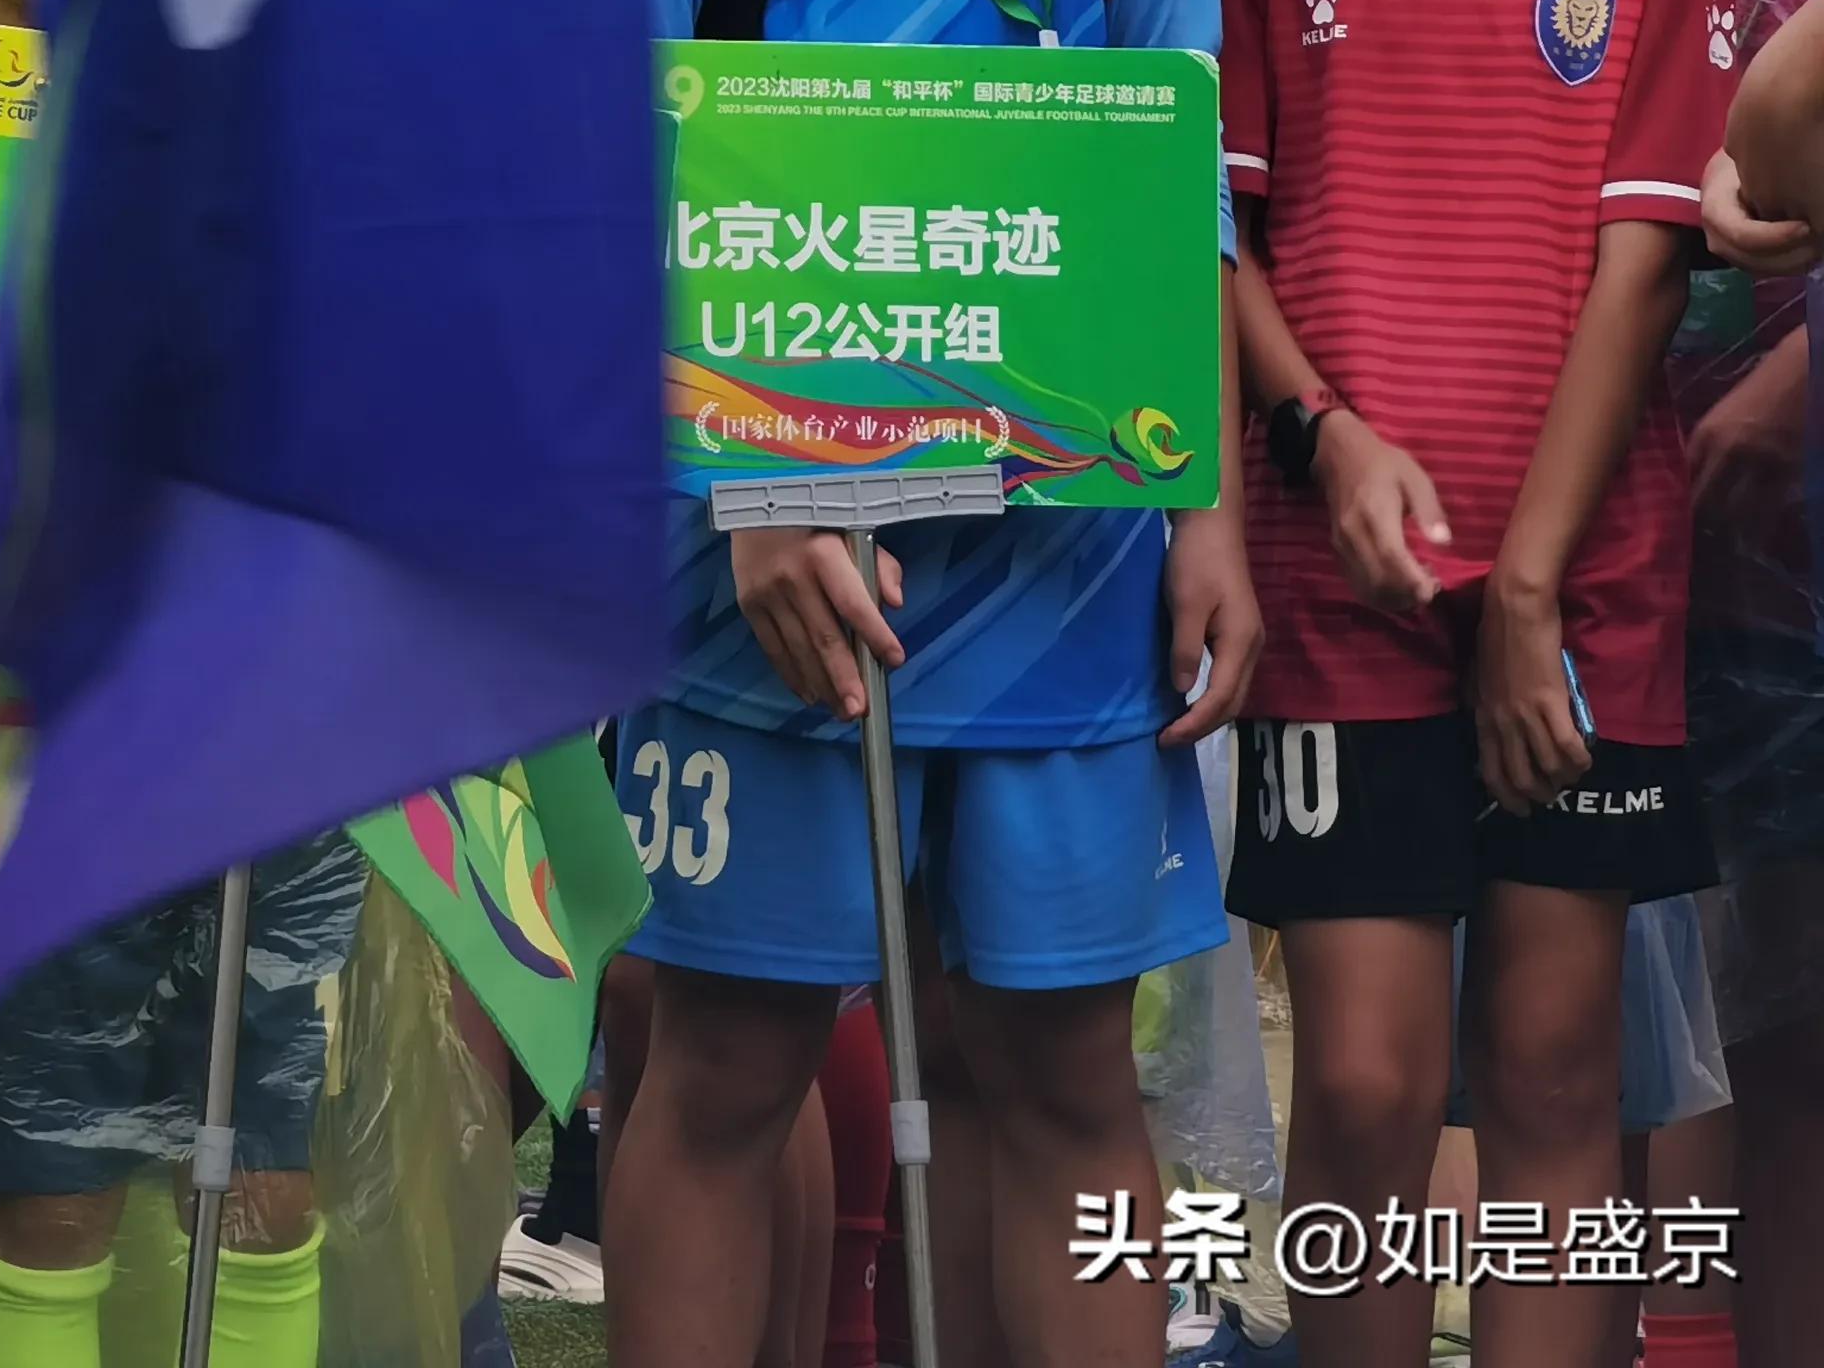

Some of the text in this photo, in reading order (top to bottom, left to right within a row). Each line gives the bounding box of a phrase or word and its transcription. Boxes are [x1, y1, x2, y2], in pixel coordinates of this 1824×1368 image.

[8, 106, 38, 122] CUP
[742, 104, 802, 115] SHENYANG
[804, 105, 823, 115] THE
[848, 106, 883, 117] PEACE
[885, 106, 907, 118] CUP
[1046, 110, 1101, 122] FOOTBALL
[701, 300, 1004, 362] U12公开组
[623, 739, 731, 886] 33
[1254, 722, 1339, 843] 30
